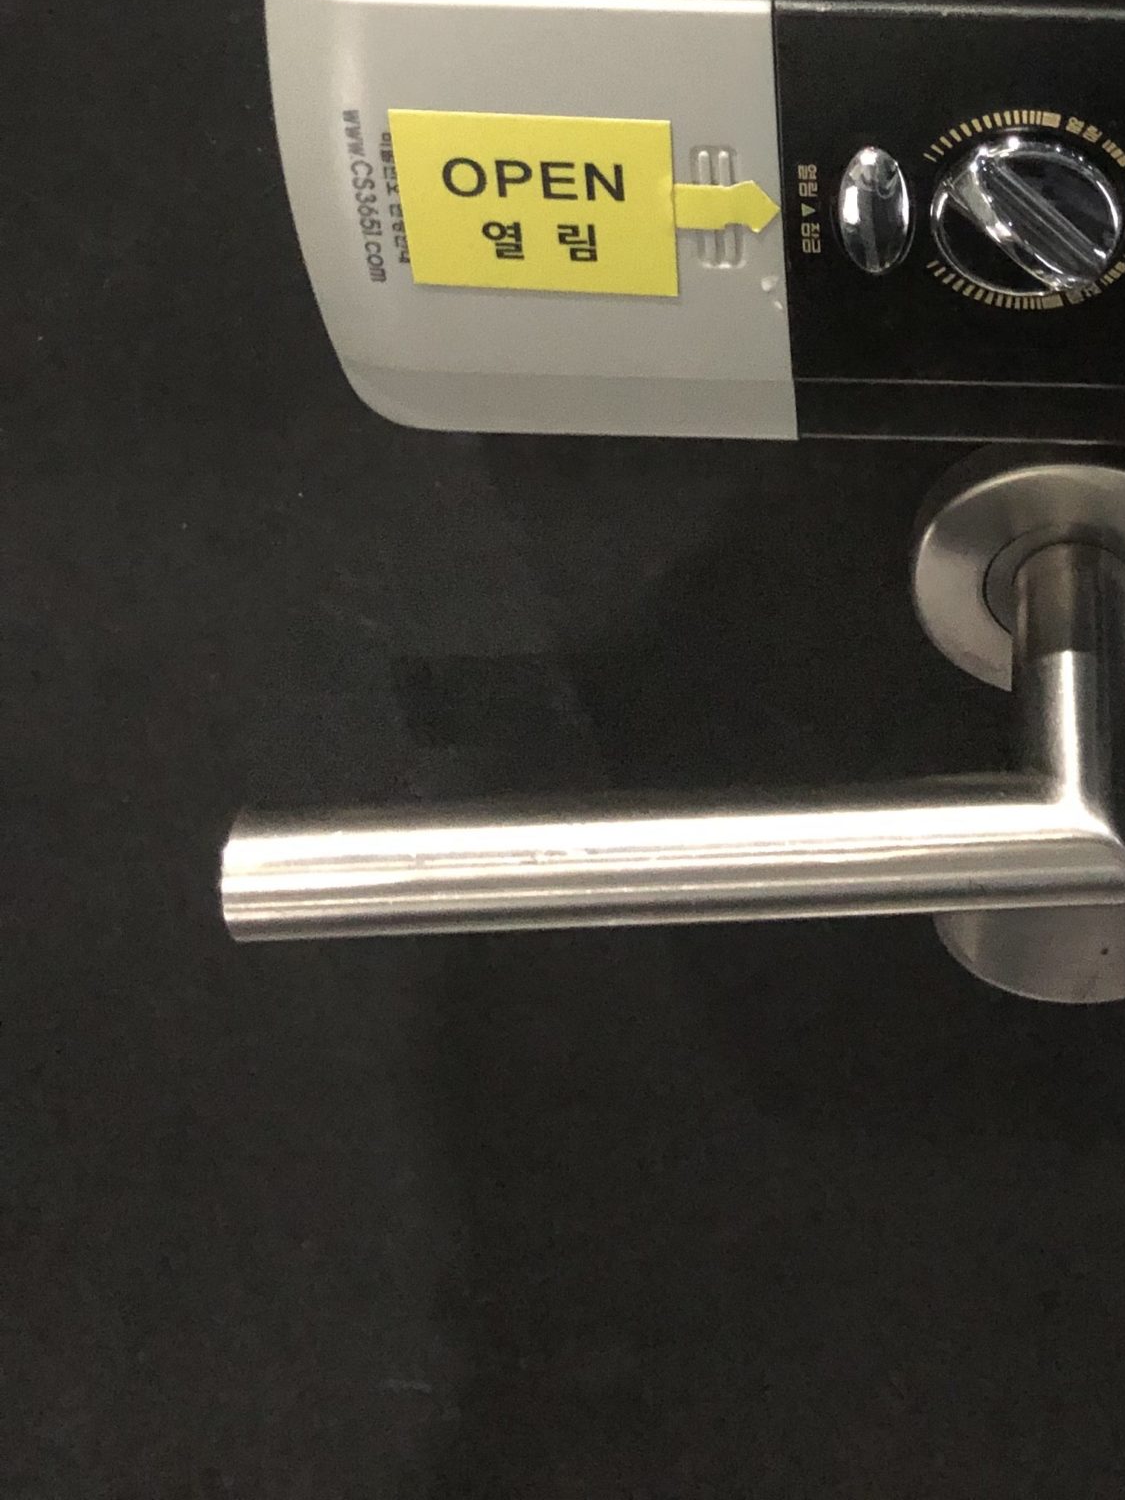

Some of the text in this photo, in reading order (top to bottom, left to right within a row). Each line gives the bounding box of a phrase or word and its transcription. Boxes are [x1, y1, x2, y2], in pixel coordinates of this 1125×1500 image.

[442, 157, 626, 202] OPEN
[797, 164, 818, 197] 열림
[800, 222, 821, 253] 잠금
